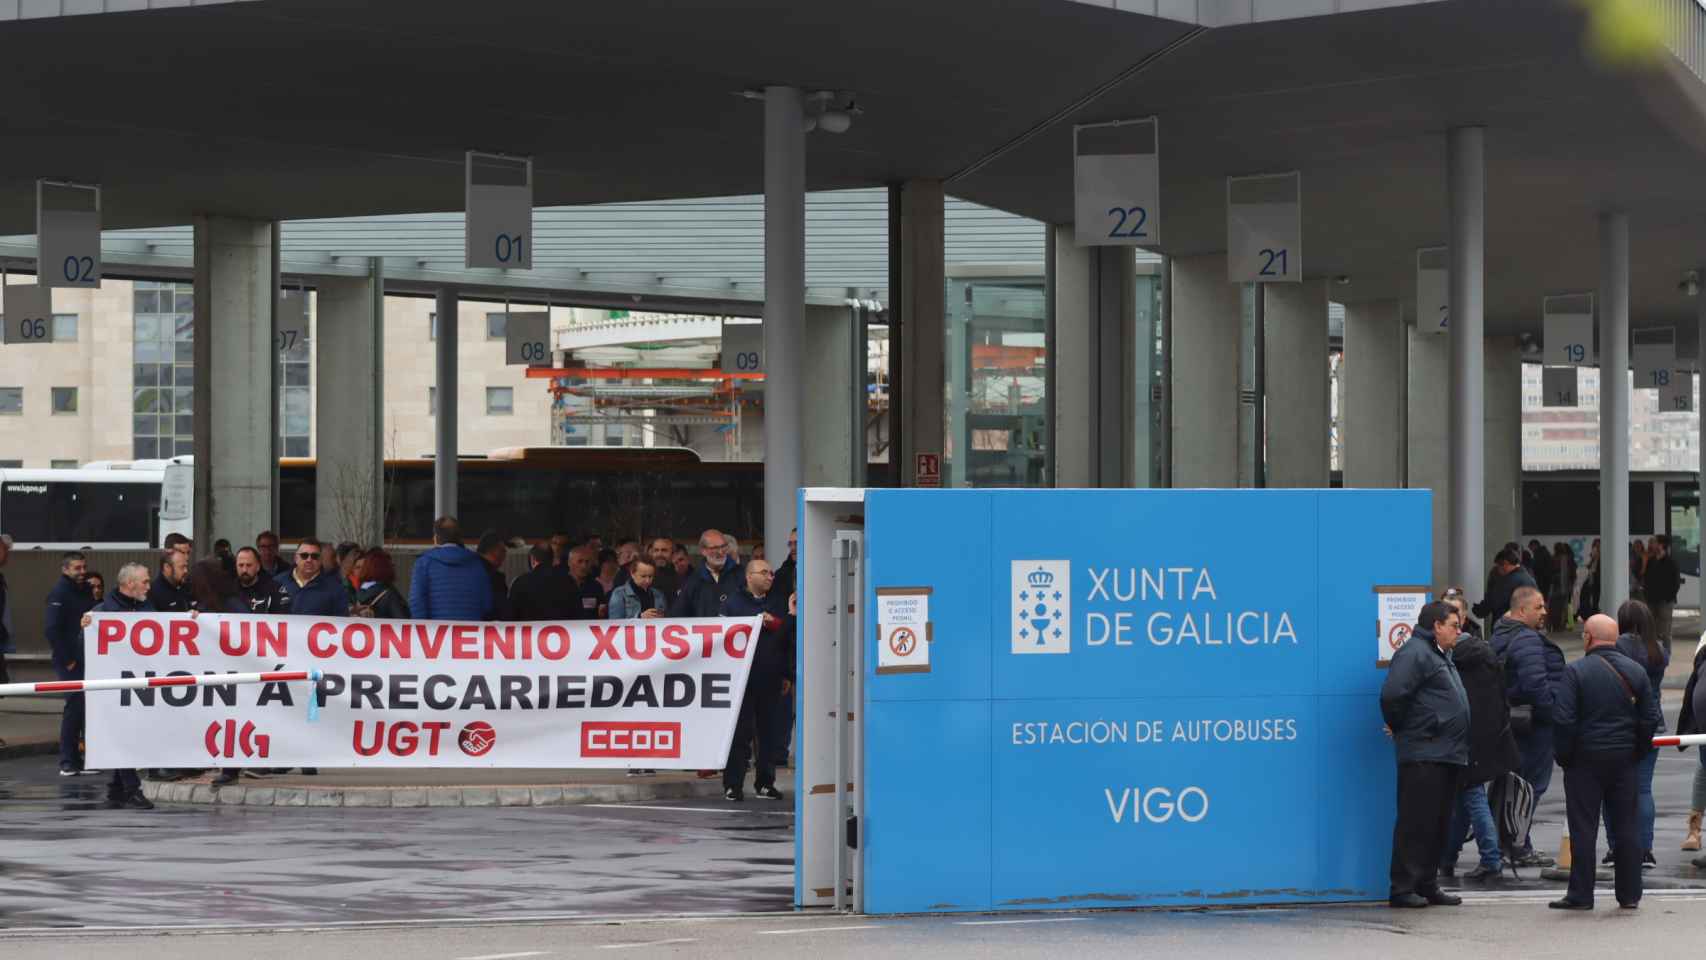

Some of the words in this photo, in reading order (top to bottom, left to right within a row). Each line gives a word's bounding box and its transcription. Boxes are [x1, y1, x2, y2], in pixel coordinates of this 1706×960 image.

[1108, 207, 1147, 238] 22
[495, 233, 523, 263] 01
[63, 256, 94, 282] 02
[1258, 249, 1288, 275] 21
[20, 318, 46, 339] 06
[520, 342, 545, 361] 08
[736, 352, 759, 370] 09
[1564, 344, 1585, 362] 19
[1652, 369, 1670, 386] 18
[1674, 396, 1688, 409] 15
[1087, 567, 1217, 602] XUNTA
[97, 619, 200, 656] POR
[219, 621, 288, 657] UN
[307, 622, 571, 660] CONVENIO
[589, 623, 753, 661] XUSTO
[1086, 612, 1134, 646] DE
[1147, 611, 1298, 646] GALICIA
[120, 670, 238, 707] NON
[256, 664, 294, 706] Á
[316, 673, 732, 710] PRECARIEDADE
[205, 719, 269, 758] CIG
[353, 719, 450, 756] UGT
[588, 730, 674, 749] CCOO
[1011, 717, 1128, 744] ESTACIÓN
[1136, 721, 1163, 743] DE
[1171, 719, 1298, 742] AUTOBUSES
[1103, 786, 1210, 823] VIGO
